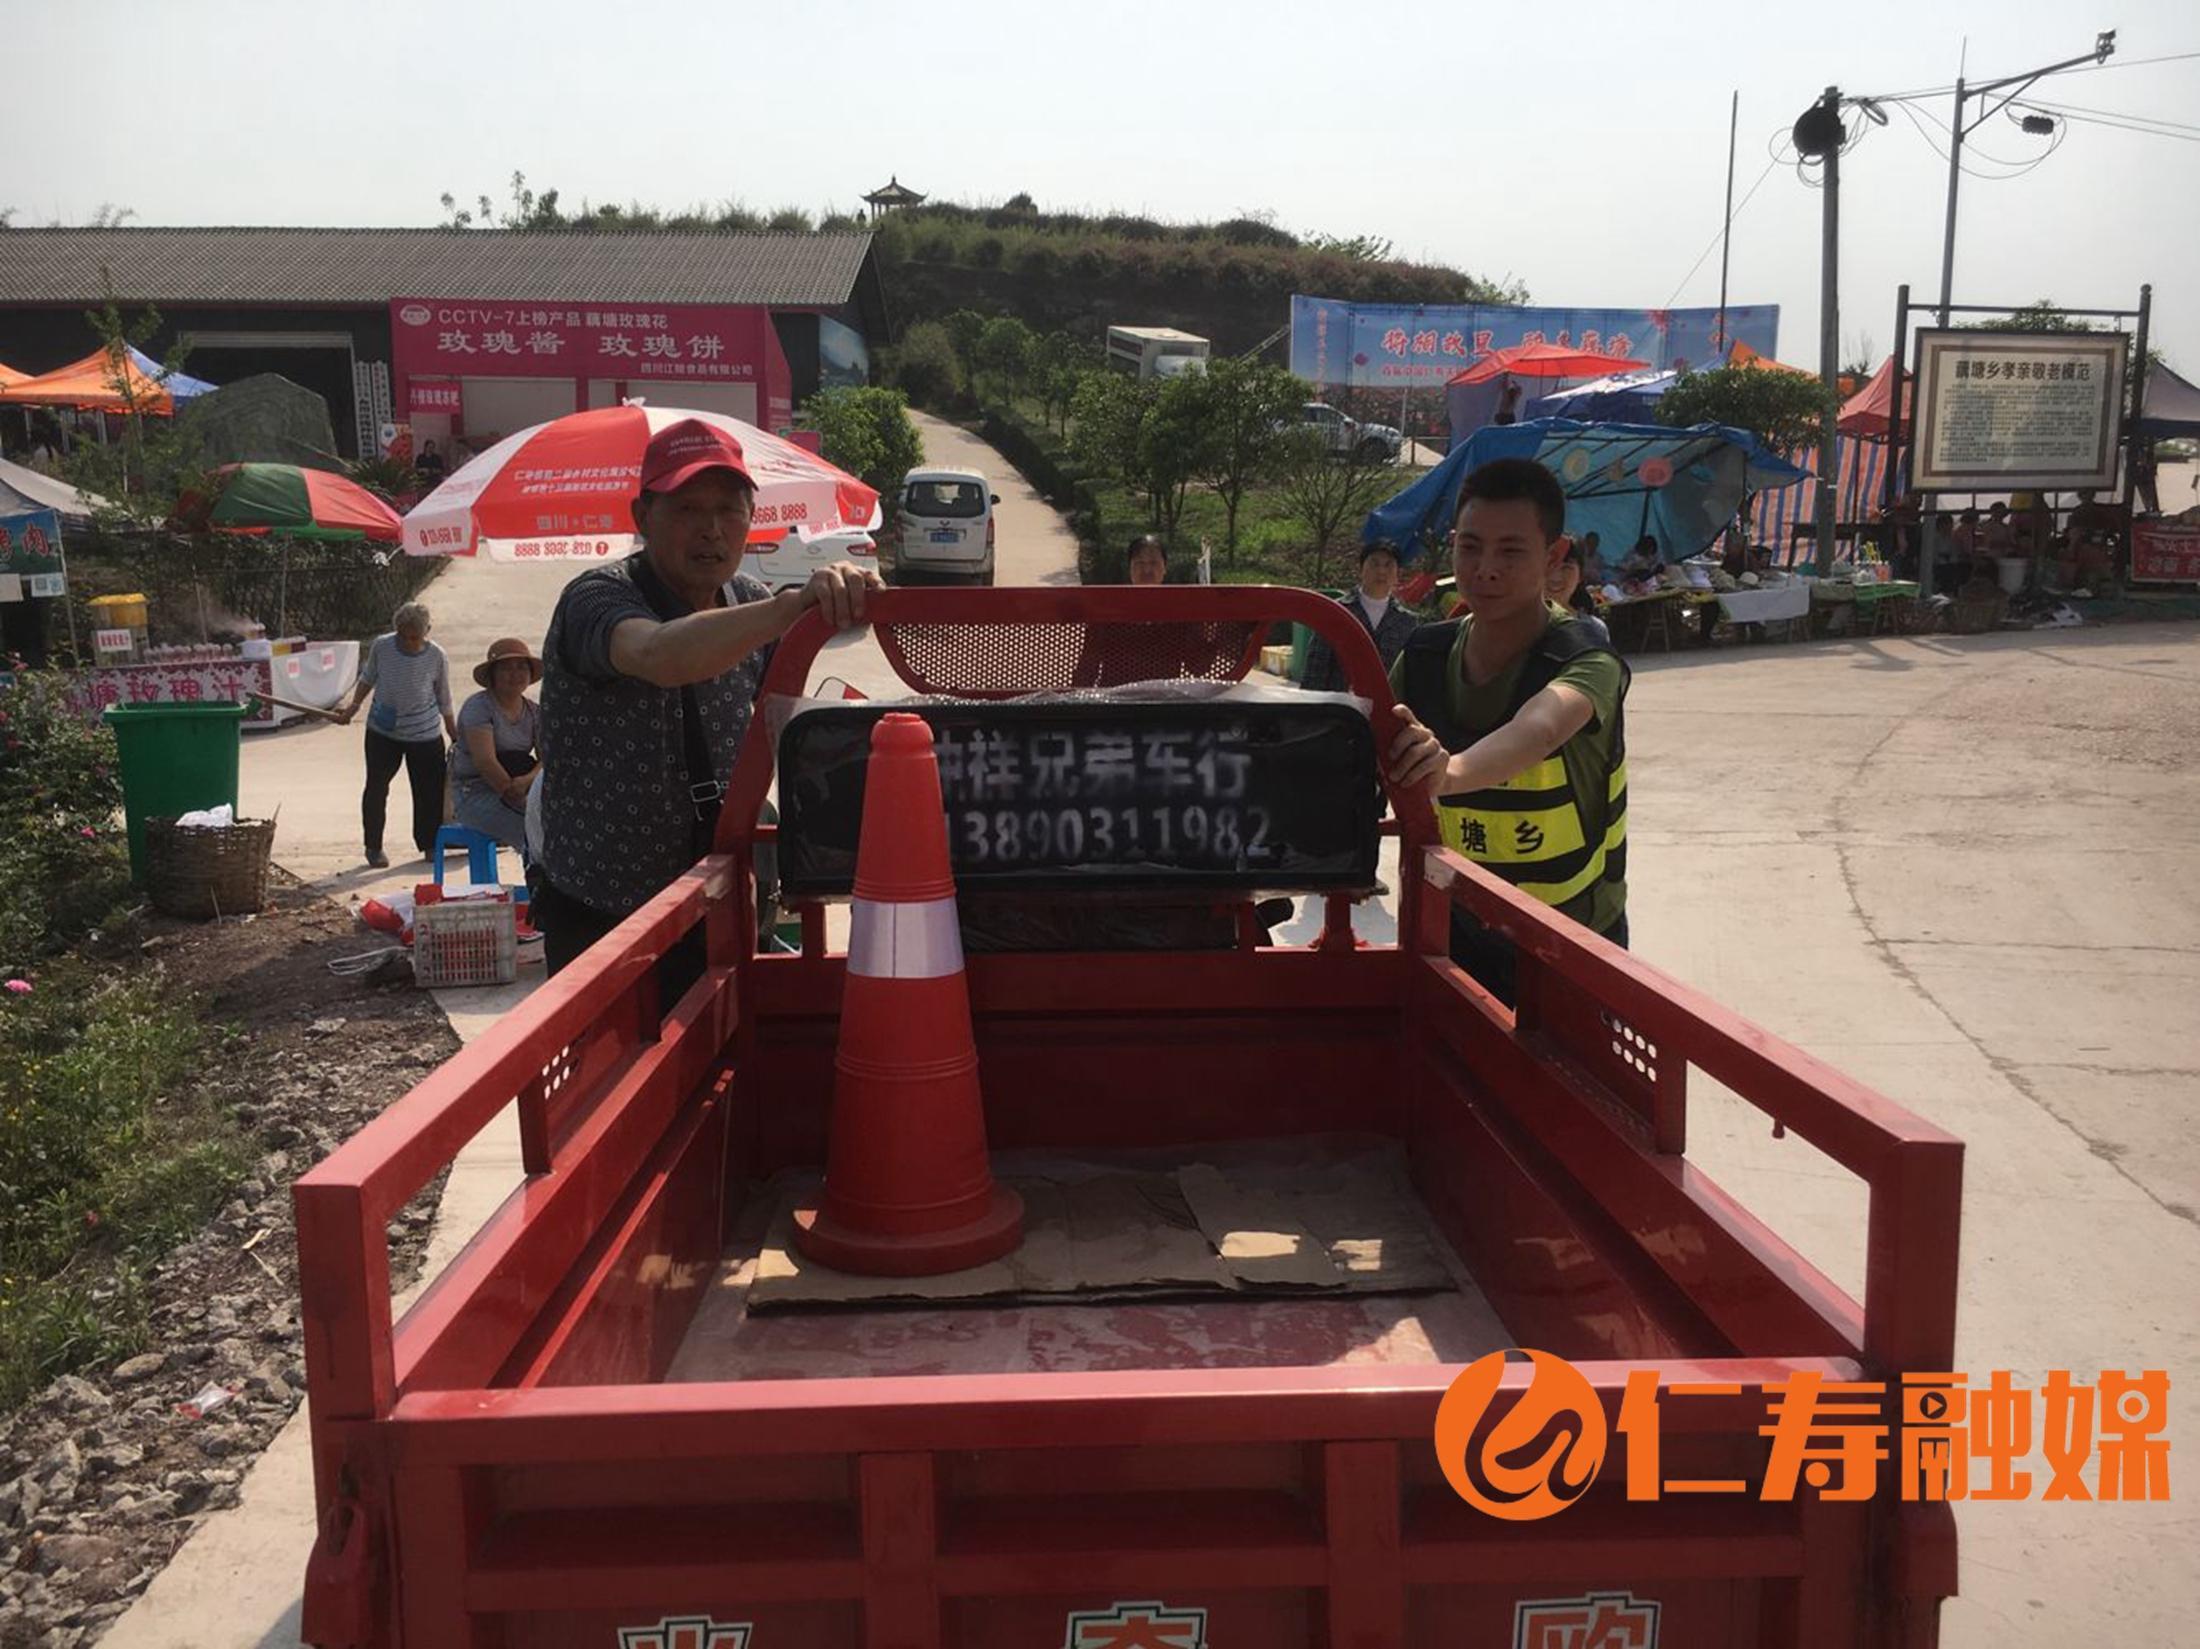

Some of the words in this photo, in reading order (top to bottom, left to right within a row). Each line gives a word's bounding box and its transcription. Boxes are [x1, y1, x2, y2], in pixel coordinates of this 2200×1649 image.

[437, 330, 566, 356] 玫瑰酱
[597, 333, 726, 360] 玫瑰饼
[1955, 360, 2091, 382] 藕塘乡孝亲敬老模范
